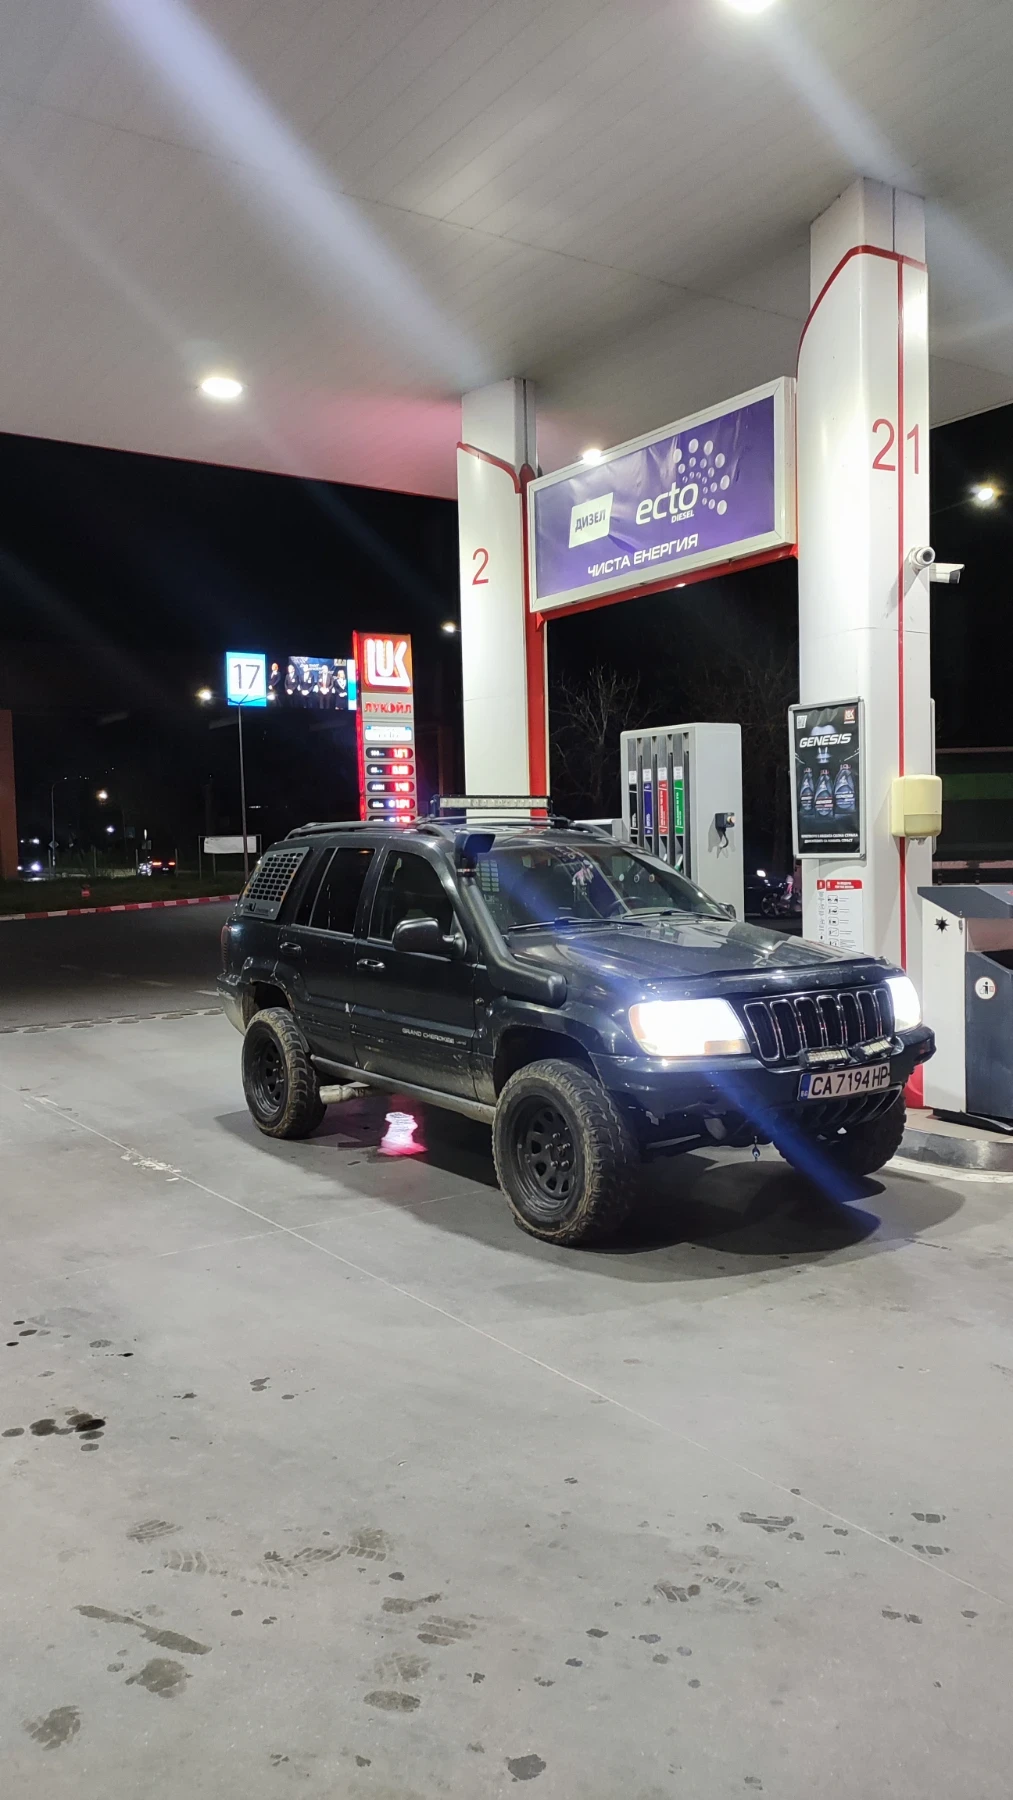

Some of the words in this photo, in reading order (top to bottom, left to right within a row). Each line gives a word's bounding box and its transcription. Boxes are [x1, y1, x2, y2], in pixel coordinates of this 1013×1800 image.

[872, 418, 896, 472] 2
[906, 423, 919, 475] 1
[635, 481, 699, 525] ecto
[671, 510, 695, 524] DIESEL
[575, 509, 606, 532] ДИЗЕЛ
[472, 547, 489, 585] 2
[587, 555, 631, 577] ЧИСТА
[633, 533, 699, 565] ЕНЕРГИЯ
[233, 663, 261, 690] 17
[799, 733, 852, 748] GENESIS
[401, 1027, 422, 1037] GRAND
[422, 1032, 455, 1044] CHEROKEE
[811, 1076, 832, 1096] CA
[836, 1070, 870, 1094] 7194
[872, 1066, 888, 1087] HP
